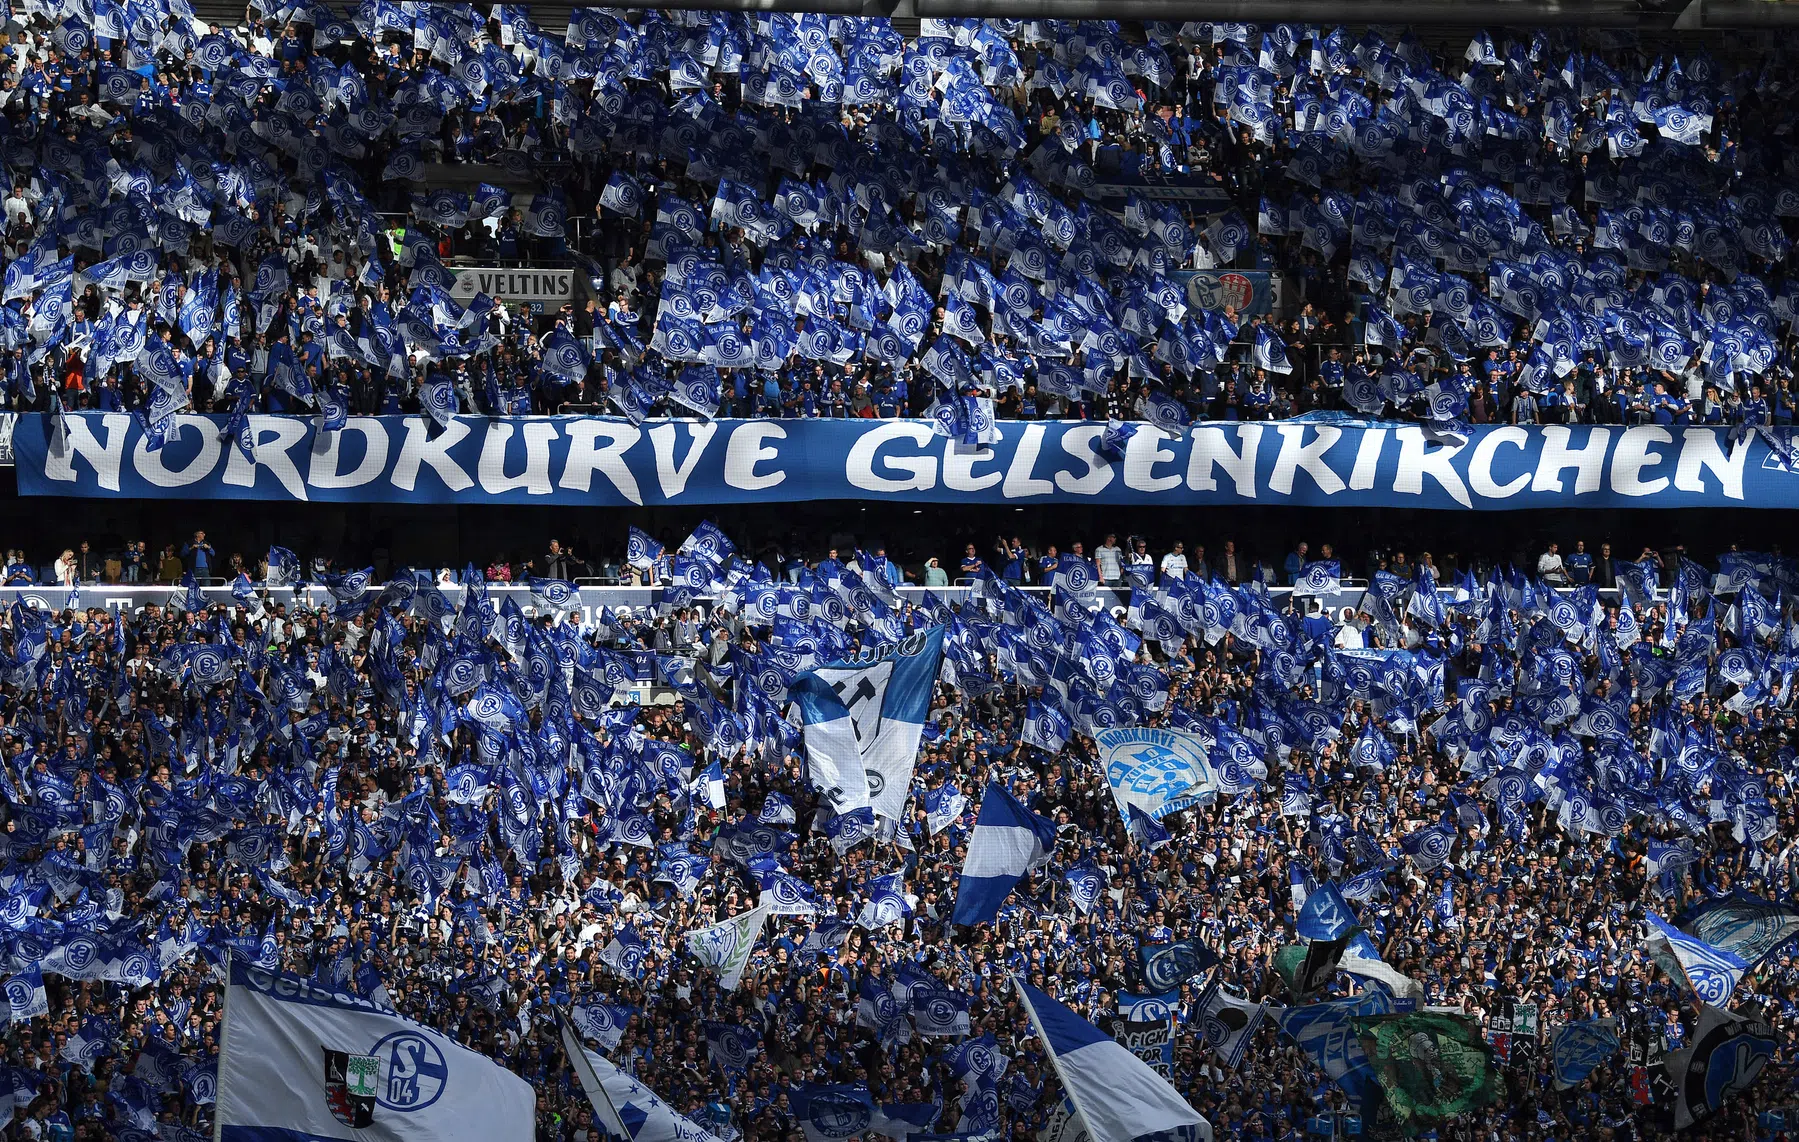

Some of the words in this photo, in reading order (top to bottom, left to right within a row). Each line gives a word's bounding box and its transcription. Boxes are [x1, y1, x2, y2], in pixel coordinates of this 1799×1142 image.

[478, 273, 569, 296] VELTINS
[530, 303, 543, 312] 32
[45, 413, 788, 506] NORDKURVE
[845, 419, 1757, 509] GELSENKIRCHEN
[636, 655, 647, 664] 04
[1100, 727, 1177, 750] NORDKURVE
[1129, 1027, 1169, 1048] FIGHT
[389, 1079, 413, 1104] 04
